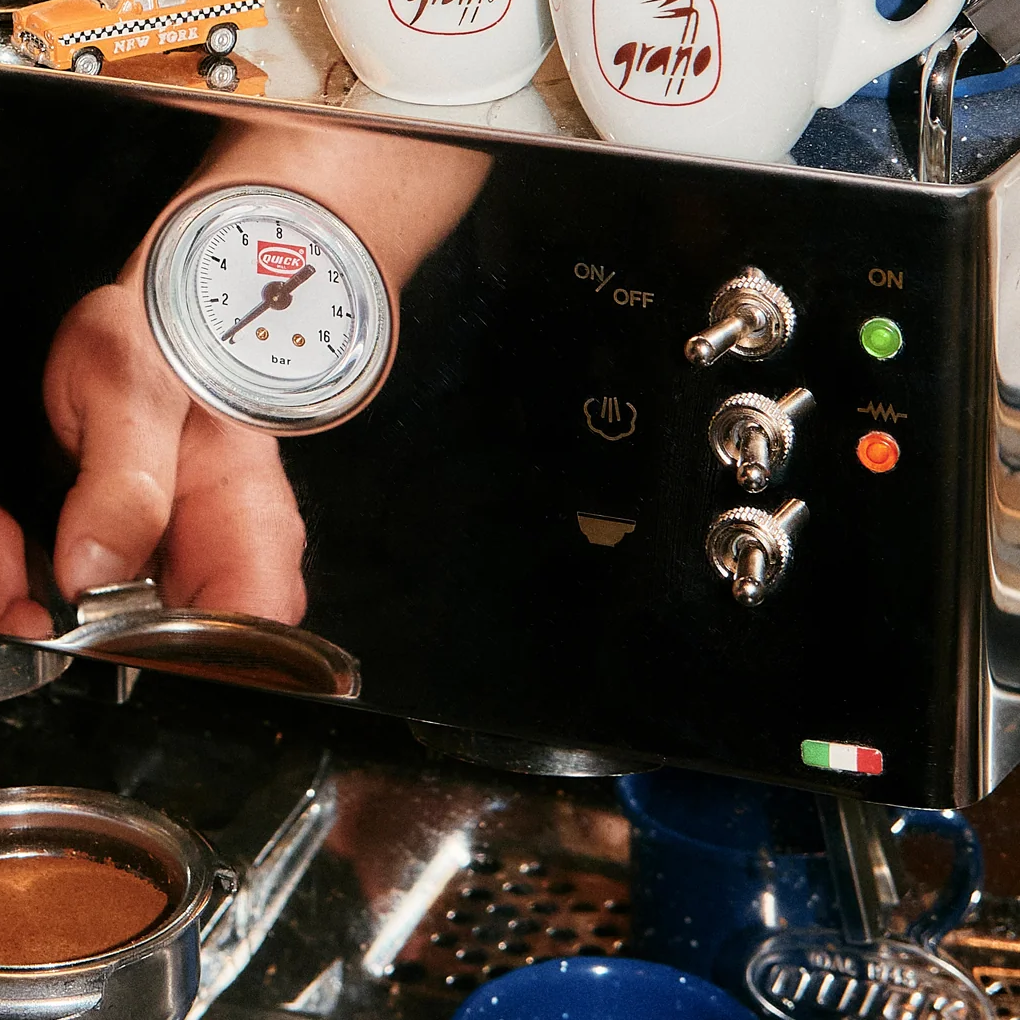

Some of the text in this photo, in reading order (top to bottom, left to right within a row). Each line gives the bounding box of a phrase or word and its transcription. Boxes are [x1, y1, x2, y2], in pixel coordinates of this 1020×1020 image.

[114, 26, 199, 55] NEW YORK
[613, 41, 712, 97] grano
[242, 233, 249, 246] 6
[275, 227, 284, 240] 8
[309, 243, 322, 257] 10
[220, 259, 227, 271] 4
[262, 254, 301, 267] QUICK
[328, 269, 340, 284] 12
[868, 268, 904, 290] ON
[221, 292, 229, 306] 2
[331, 305, 343, 318] 14
[318, 329, 331, 344] 16
[271, 354, 291, 366] bar
